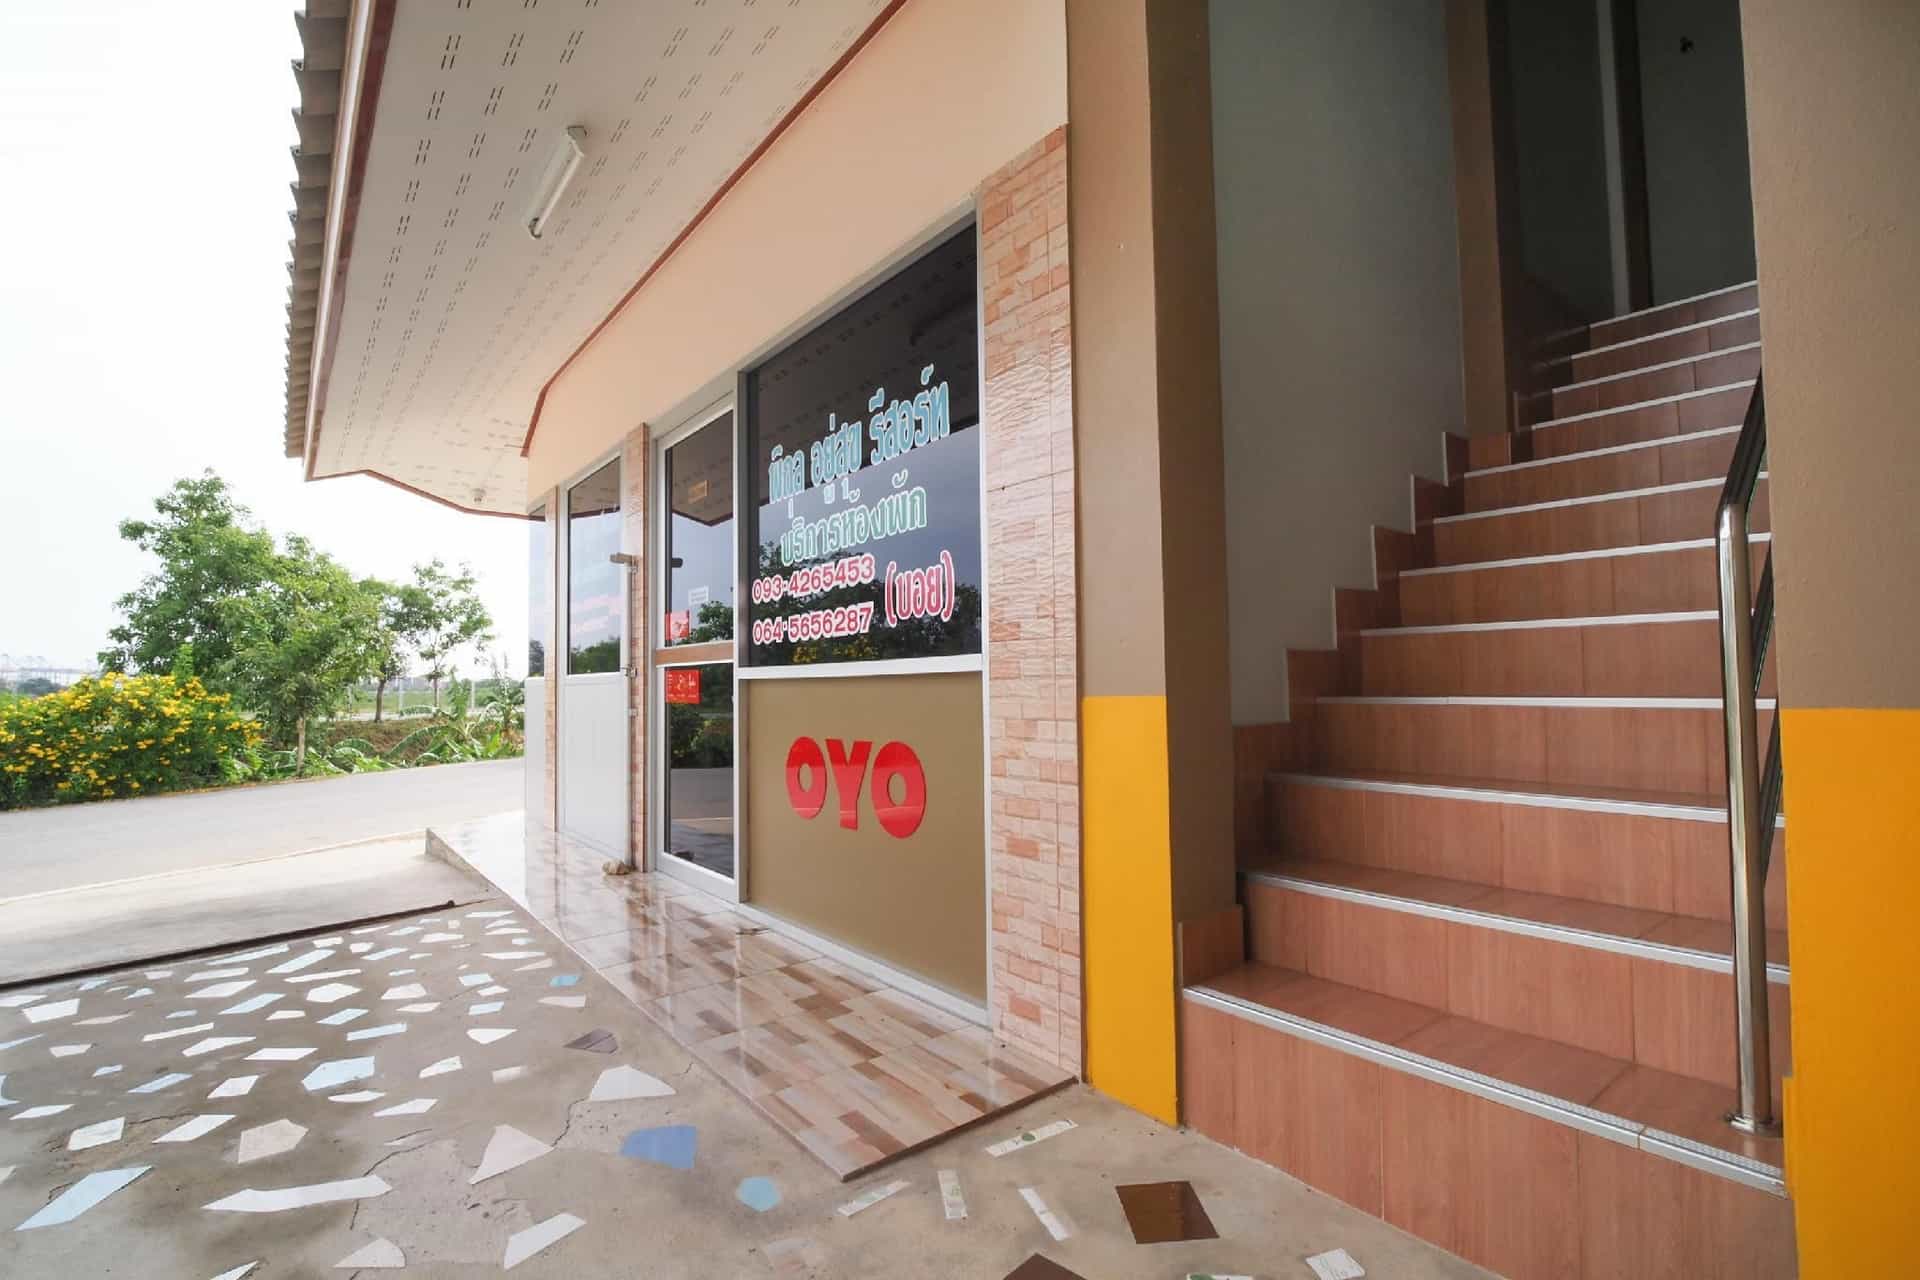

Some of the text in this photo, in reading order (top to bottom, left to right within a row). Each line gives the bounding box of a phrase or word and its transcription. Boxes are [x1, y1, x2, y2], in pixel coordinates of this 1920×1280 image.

[869, 363, 950, 466] รีสอร์ท
[780, 469, 928, 566] บริการห้องพัก
[884, 550, 955, 627] (บอย)
[785, 736, 927, 839] OYO
